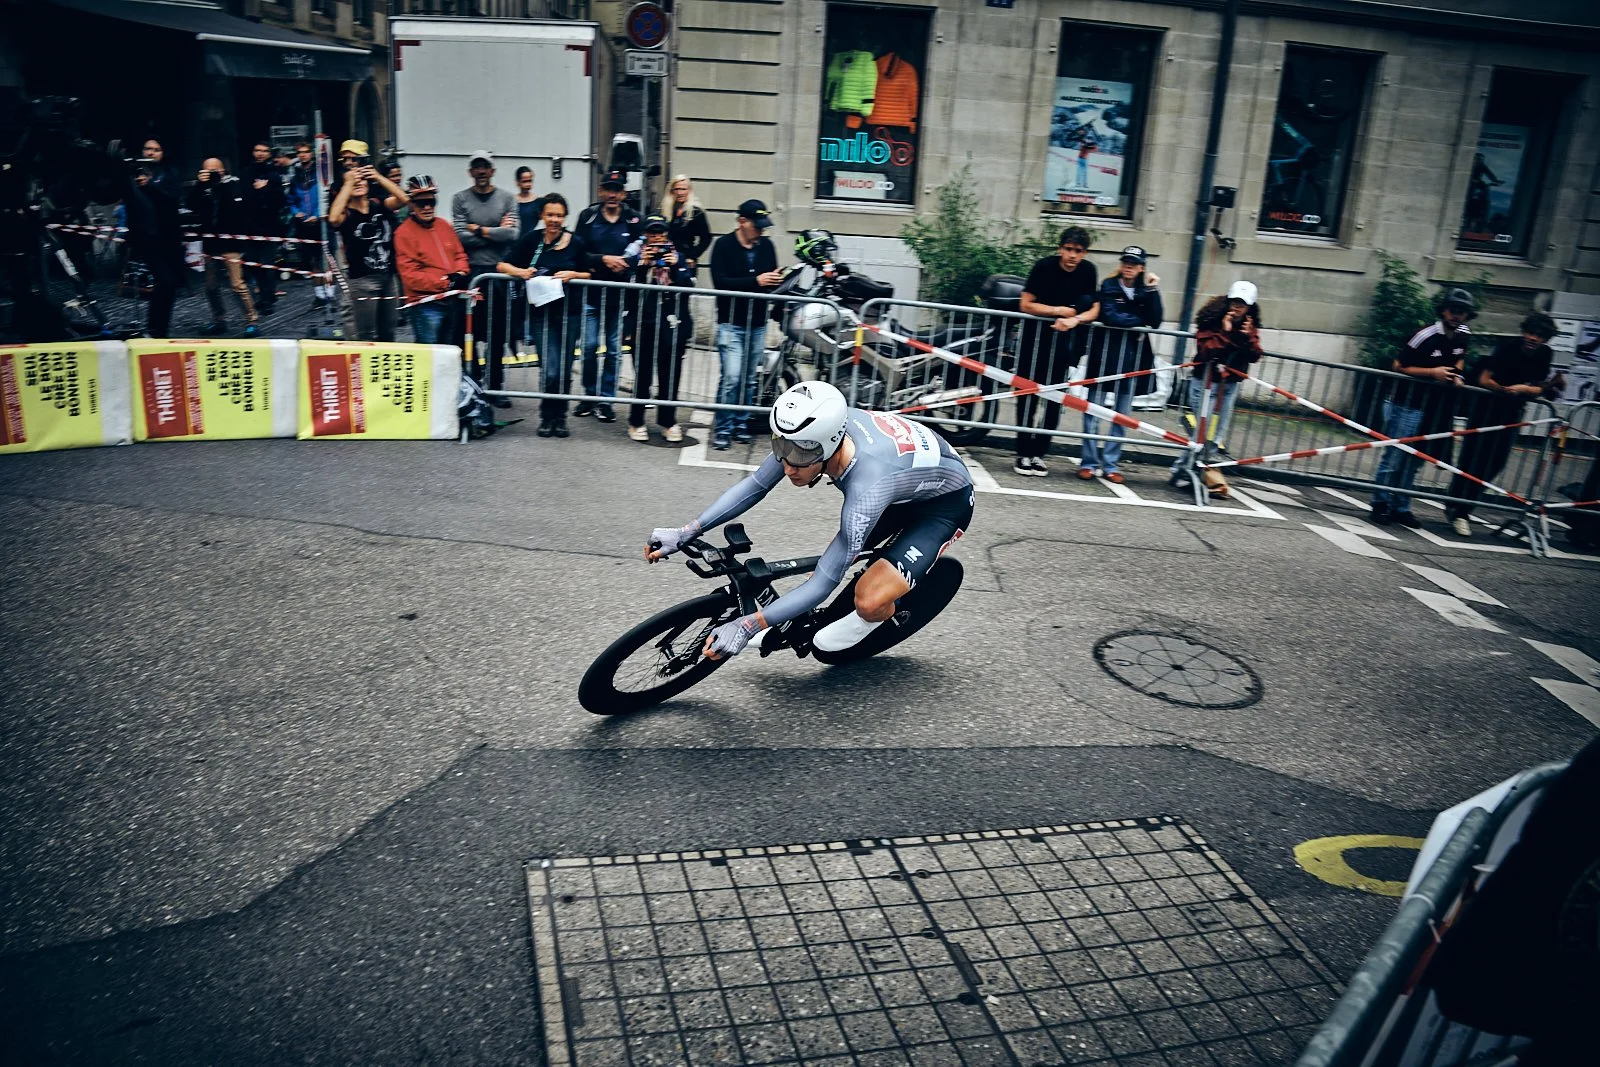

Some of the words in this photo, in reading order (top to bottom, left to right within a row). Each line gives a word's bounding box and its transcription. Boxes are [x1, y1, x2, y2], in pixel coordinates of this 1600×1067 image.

[24, 353, 38, 386] SEUL
[38, 352, 51, 382] BON
[52, 352, 64, 371] DU
[206, 351, 217, 382] SEUL
[218, 351, 229, 378] BON
[231, 351, 241, 368] DU
[370, 354, 379, 382] SEUL
[382, 354, 391, 380] BON
[393, 354, 402, 370] DU
[40, 385, 52, 401] LE
[66, 352, 81, 416] BONHEUR
[219, 382, 229, 396] LE
[243, 351, 254, 412] BONHEUR
[320, 368, 342, 423] THIRIET
[382, 384, 391, 397] LE
[404, 354, 414, 412] BONHEUR
[152, 367, 177, 425] THIRIET
